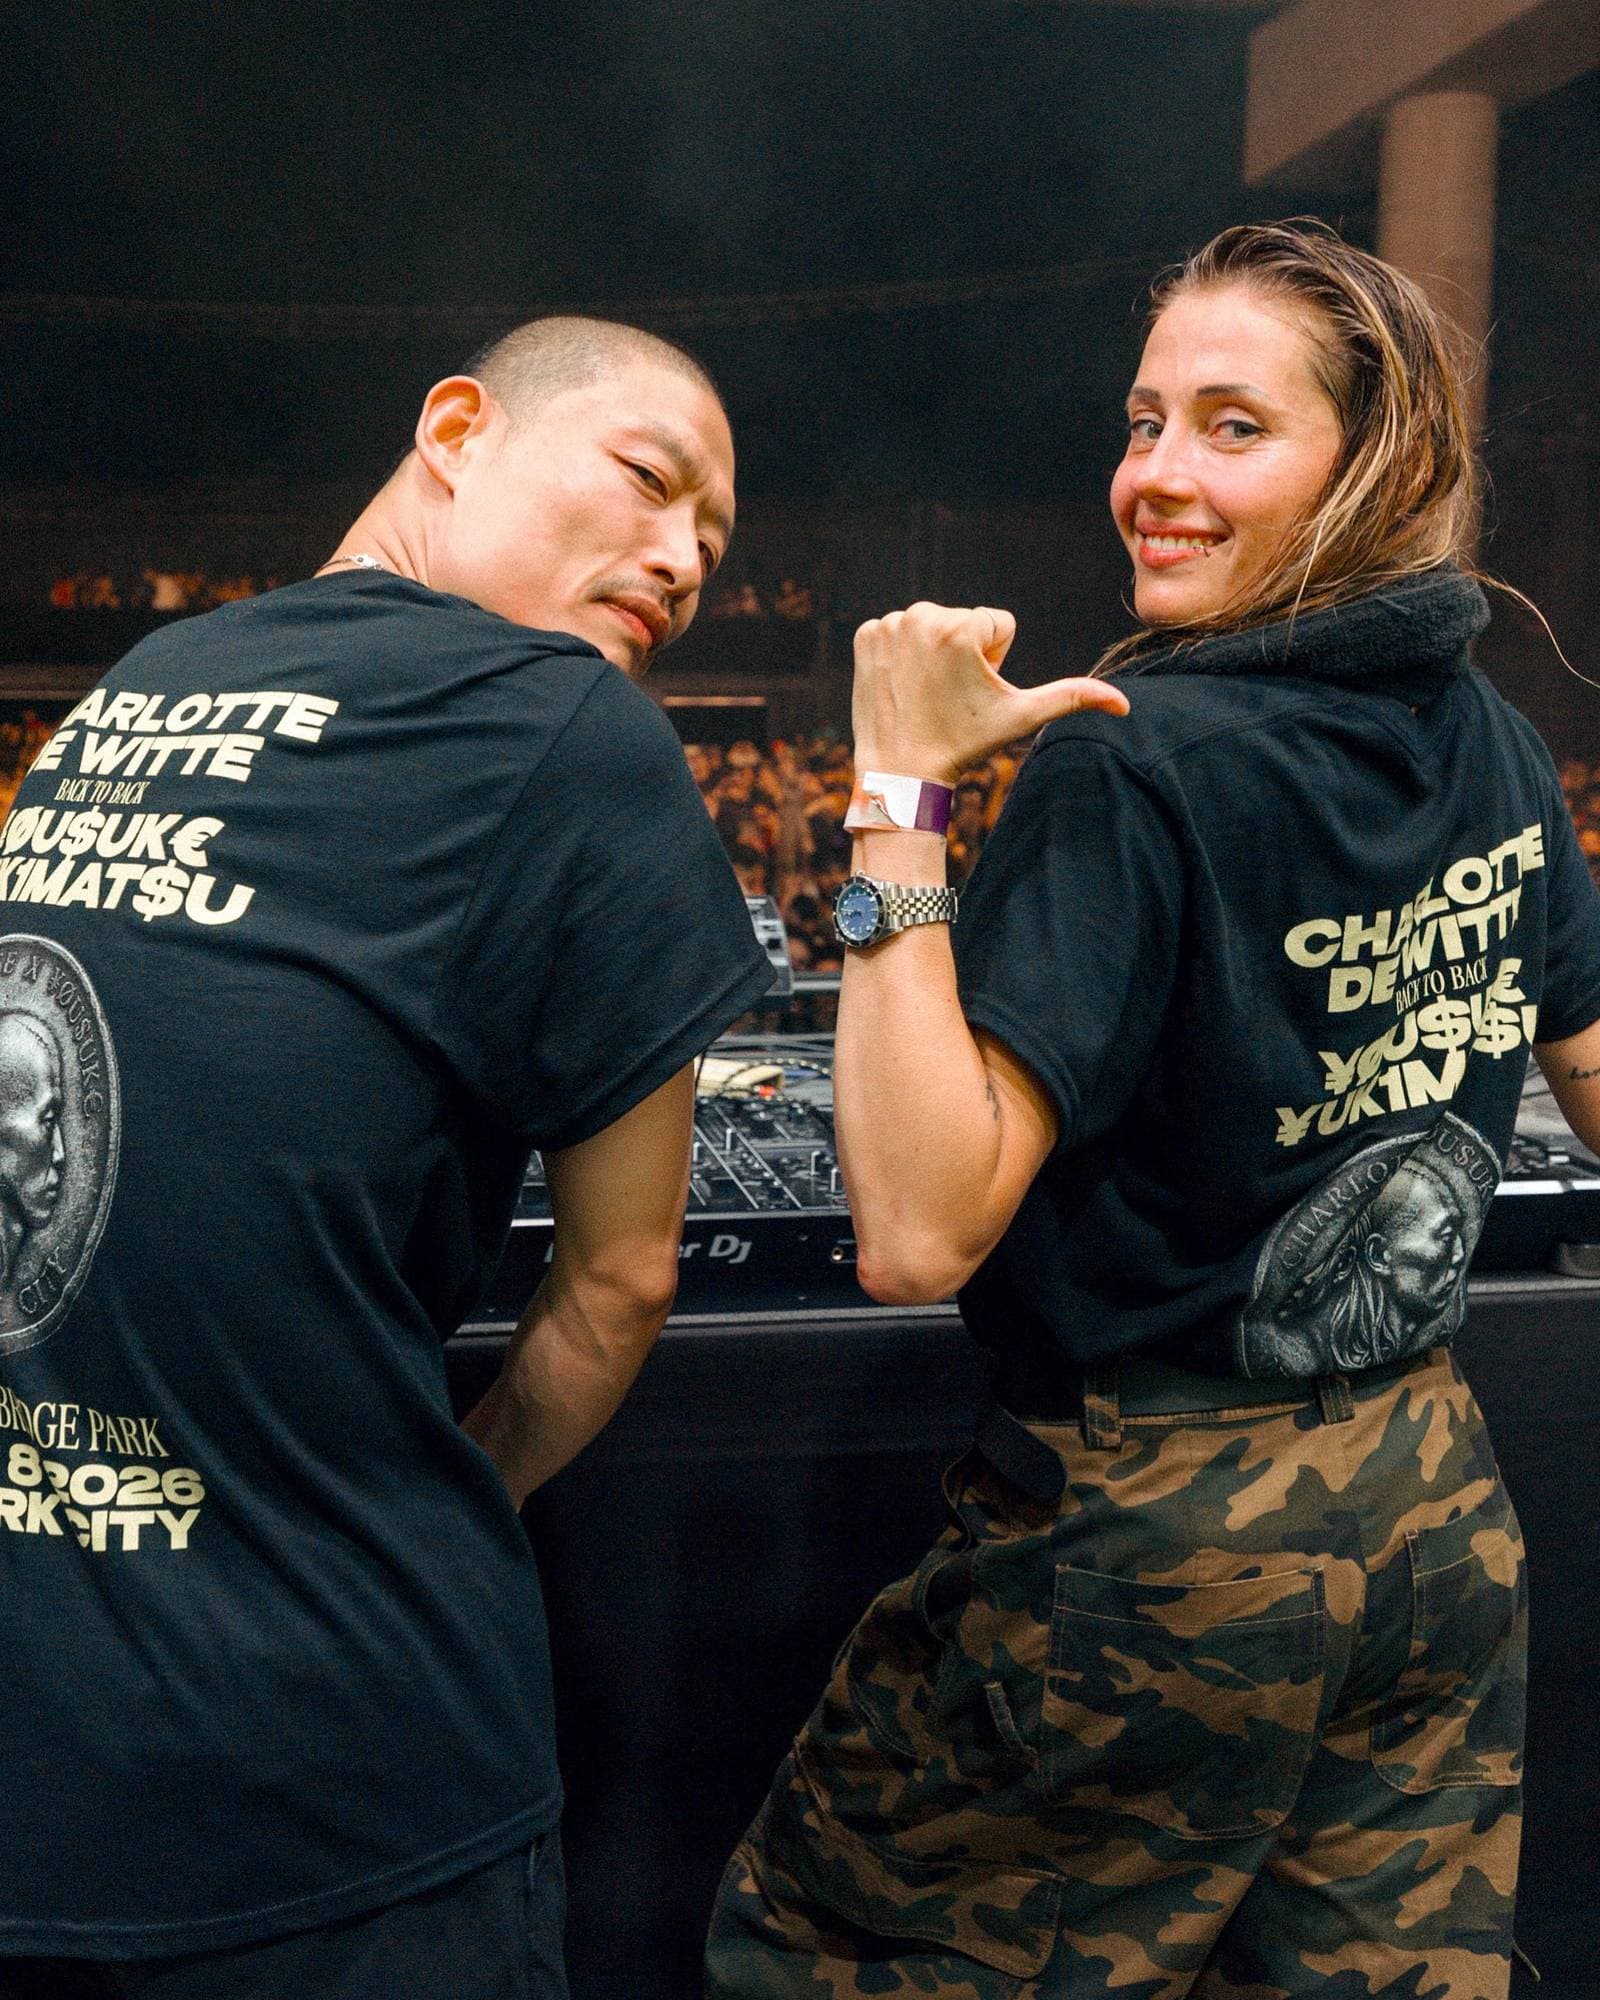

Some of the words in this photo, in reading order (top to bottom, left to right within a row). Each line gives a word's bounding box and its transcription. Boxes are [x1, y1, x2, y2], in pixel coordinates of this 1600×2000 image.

[60, 688, 339, 743] ARLOTTE
[26, 730, 79, 777] E
[79, 732, 265, 782] WITTE
[54, 778, 95, 802] BACK
[88, 780, 113, 804] TO
[107, 781, 152, 805] BACK
[1327, 955, 1400, 1013] DE
[1395, 976, 1420, 1016] BACK
[1423, 968, 1446, 997] TO
[1449, 955, 1488, 990] BACK
[1282, 1155, 1403, 1268] CHARLO
[0, 1385, 80, 1450] BRDGE
[87, 1408, 170, 1457] PARK
[8, 1443, 42, 1487] 8
[43, 1460, 206, 1506] 2026
